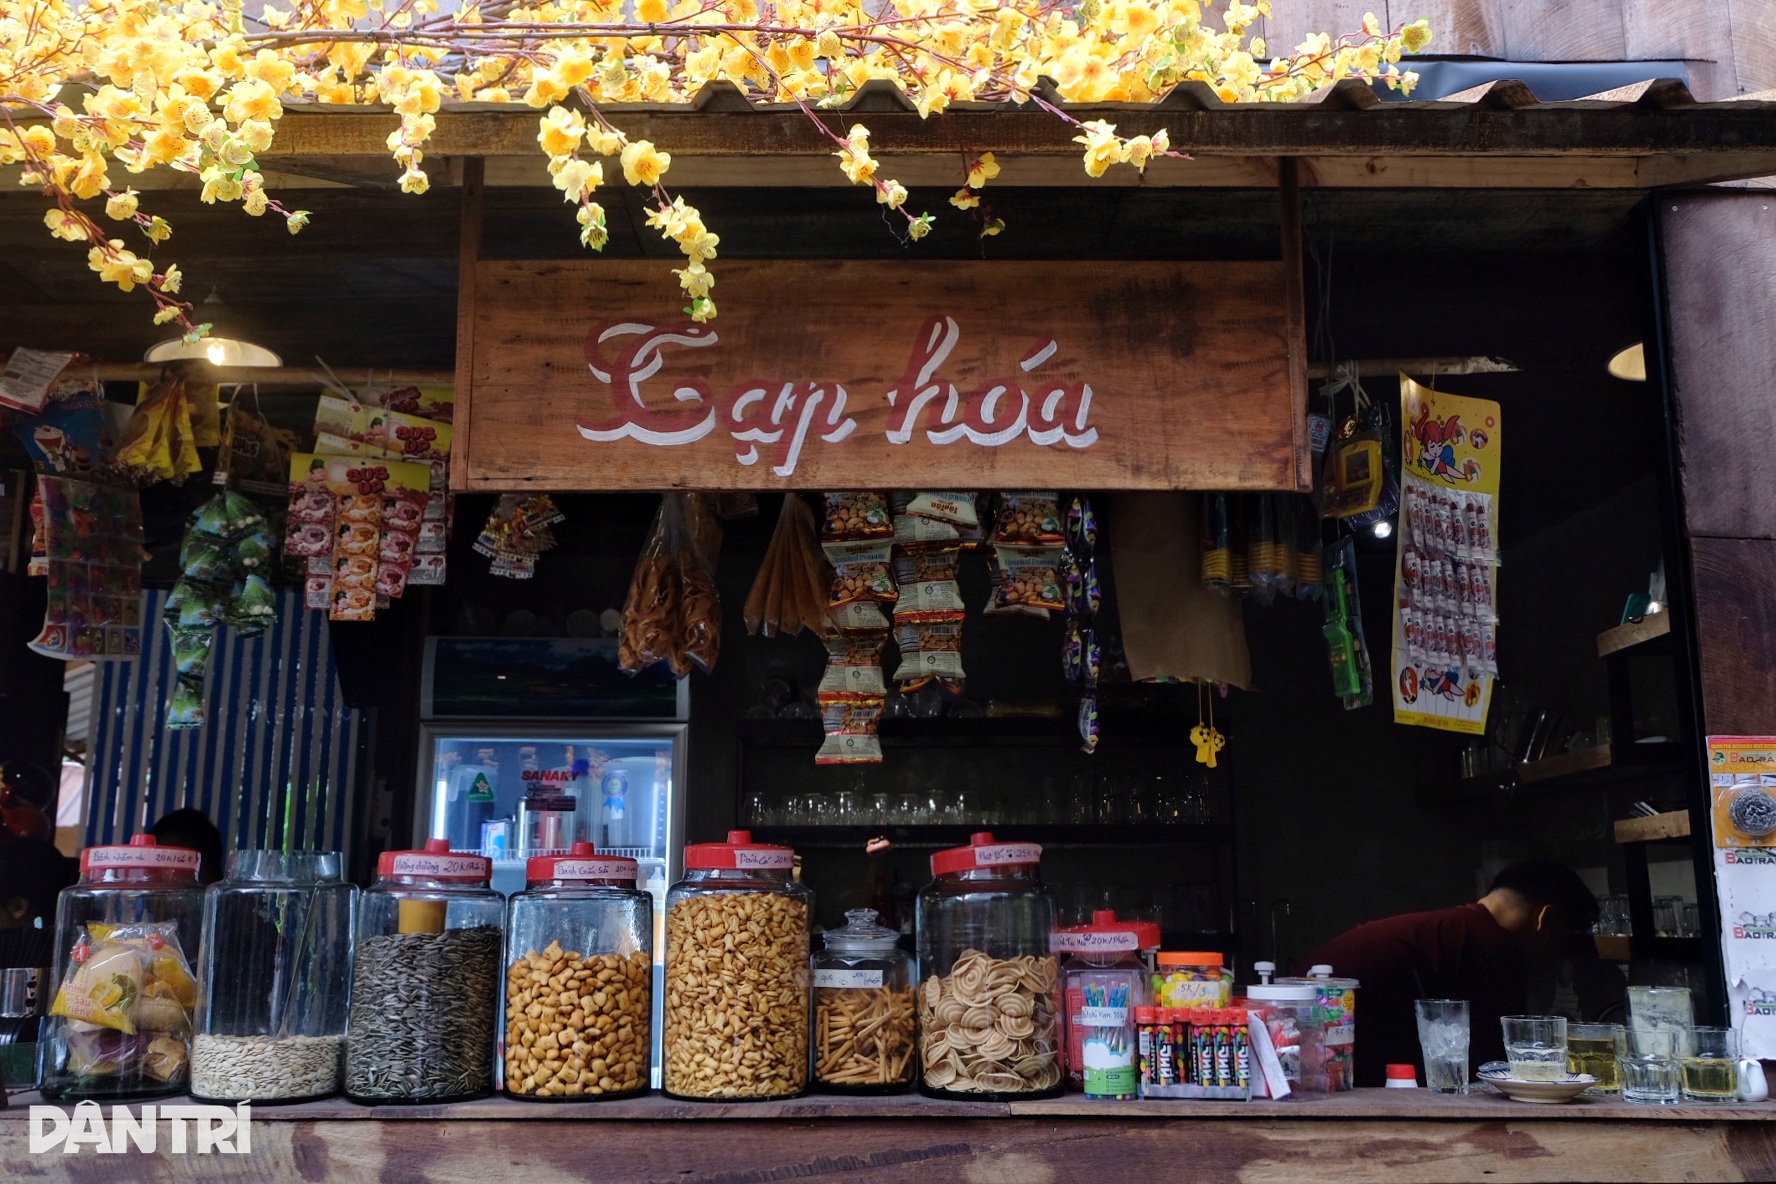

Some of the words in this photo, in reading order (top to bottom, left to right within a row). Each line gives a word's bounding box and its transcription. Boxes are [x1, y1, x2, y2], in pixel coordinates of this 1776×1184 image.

[574, 318, 857, 477] Tạp
[884, 314, 1099, 448] hóa
[521, 770, 581, 782] SANAKY
